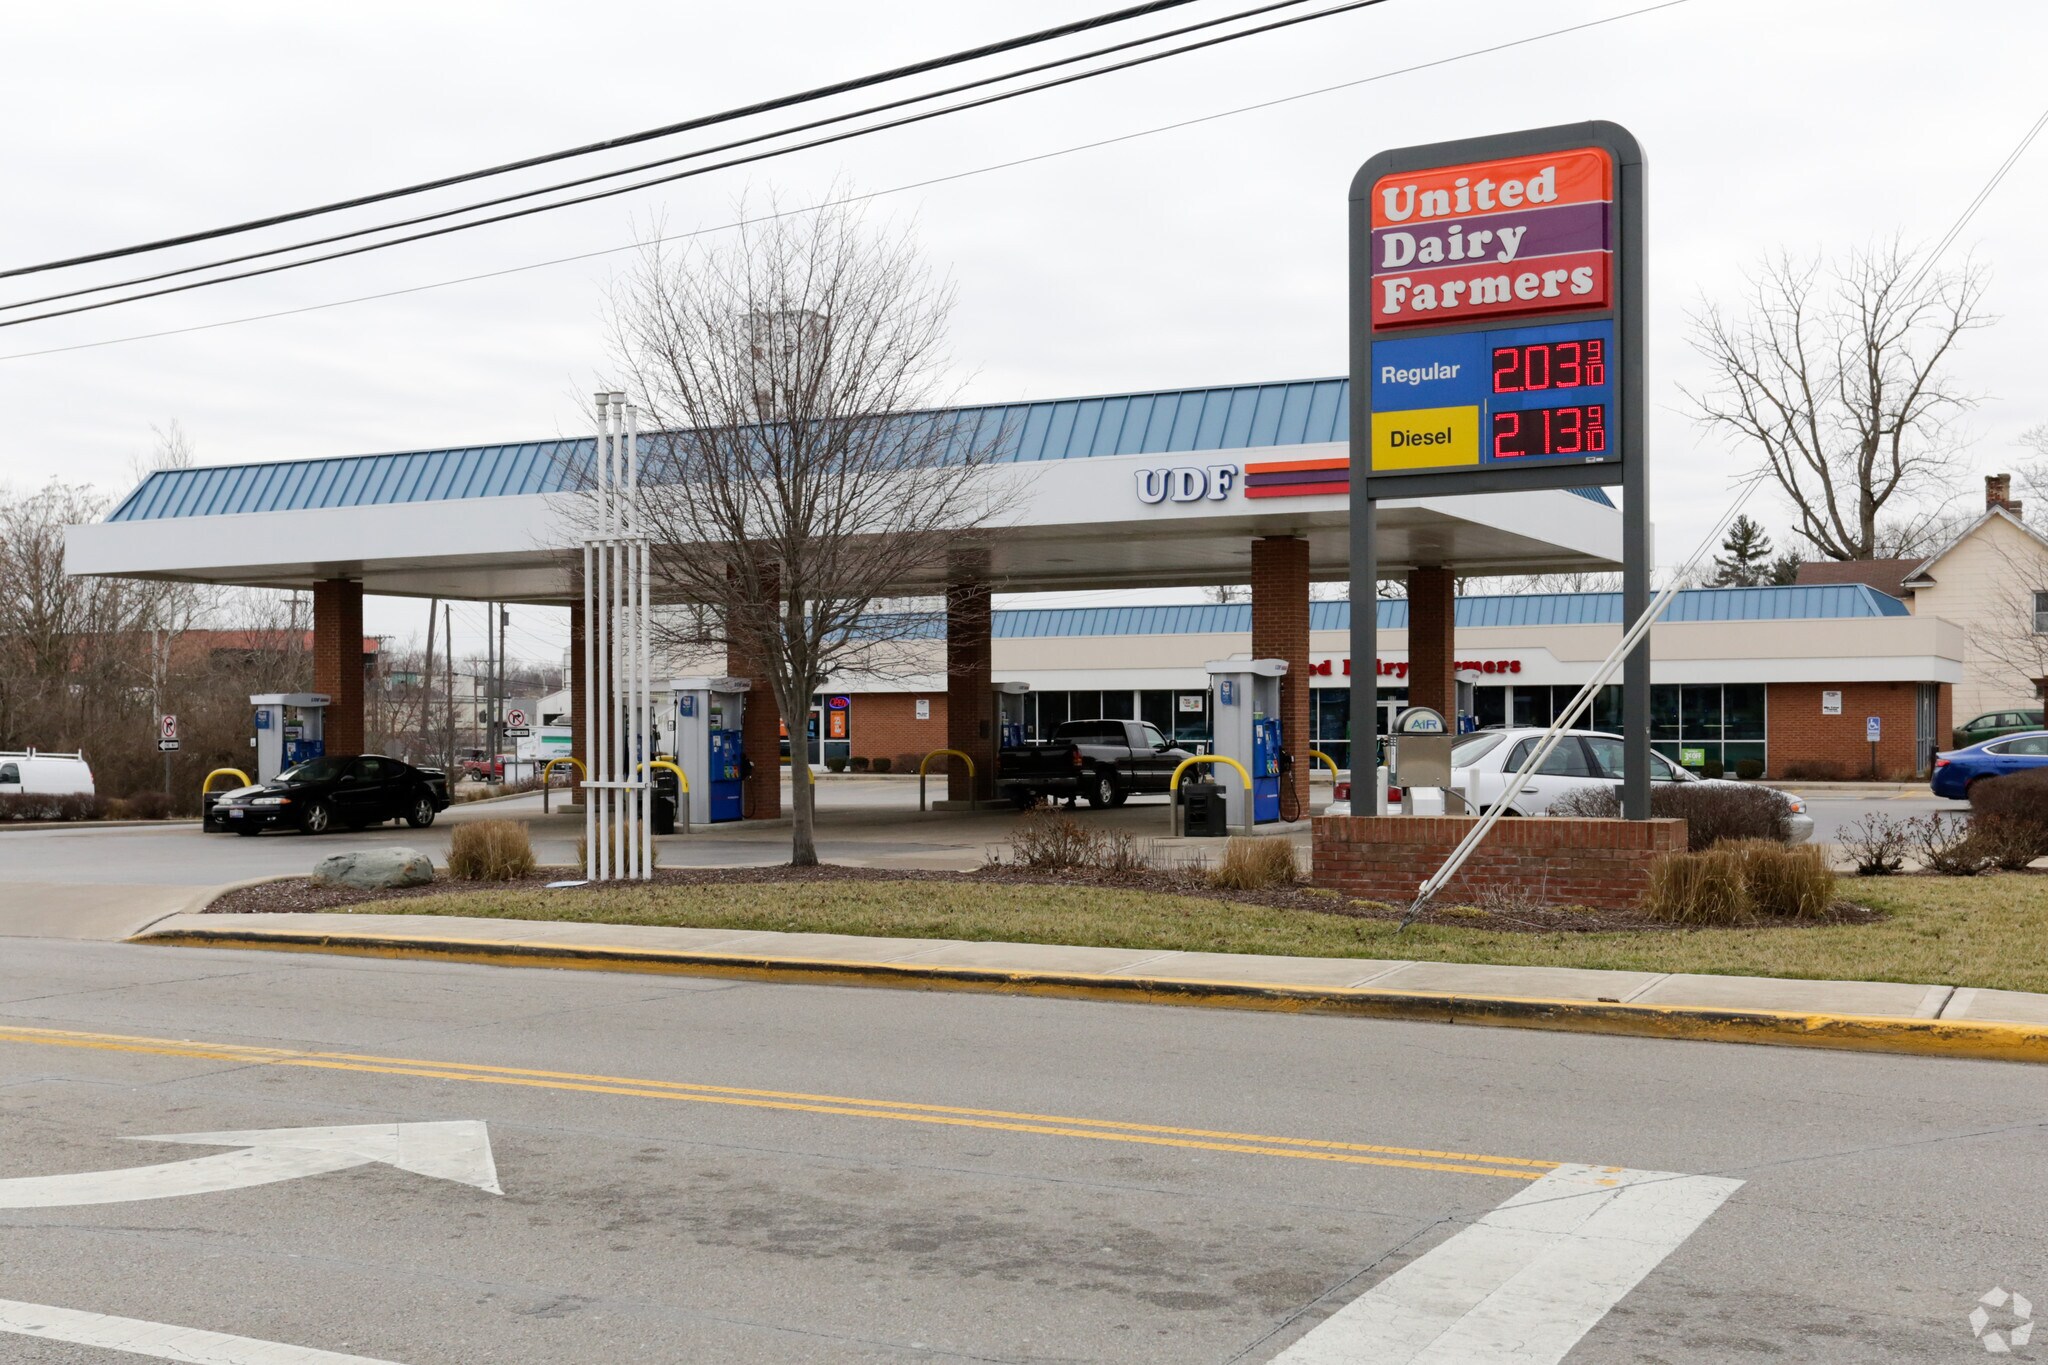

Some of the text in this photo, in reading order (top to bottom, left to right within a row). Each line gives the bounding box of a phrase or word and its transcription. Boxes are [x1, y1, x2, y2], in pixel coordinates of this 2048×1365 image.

[1382, 166, 1558, 221] United
[1382, 225, 1527, 268] Dairy
[1382, 266, 1594, 314] Farmers
[1381, 362, 1461, 386] Regular
[1494, 342, 1581, 393] 2.03
[1390, 427, 1452, 448] Diesel
[1134, 464, 1238, 504] UDF
[1343, 659, 1409, 679] iry
[1454, 660, 1521, 674] rmers
[831, 698, 848, 708] OPEN
[1411, 719, 1438, 730] AIR
